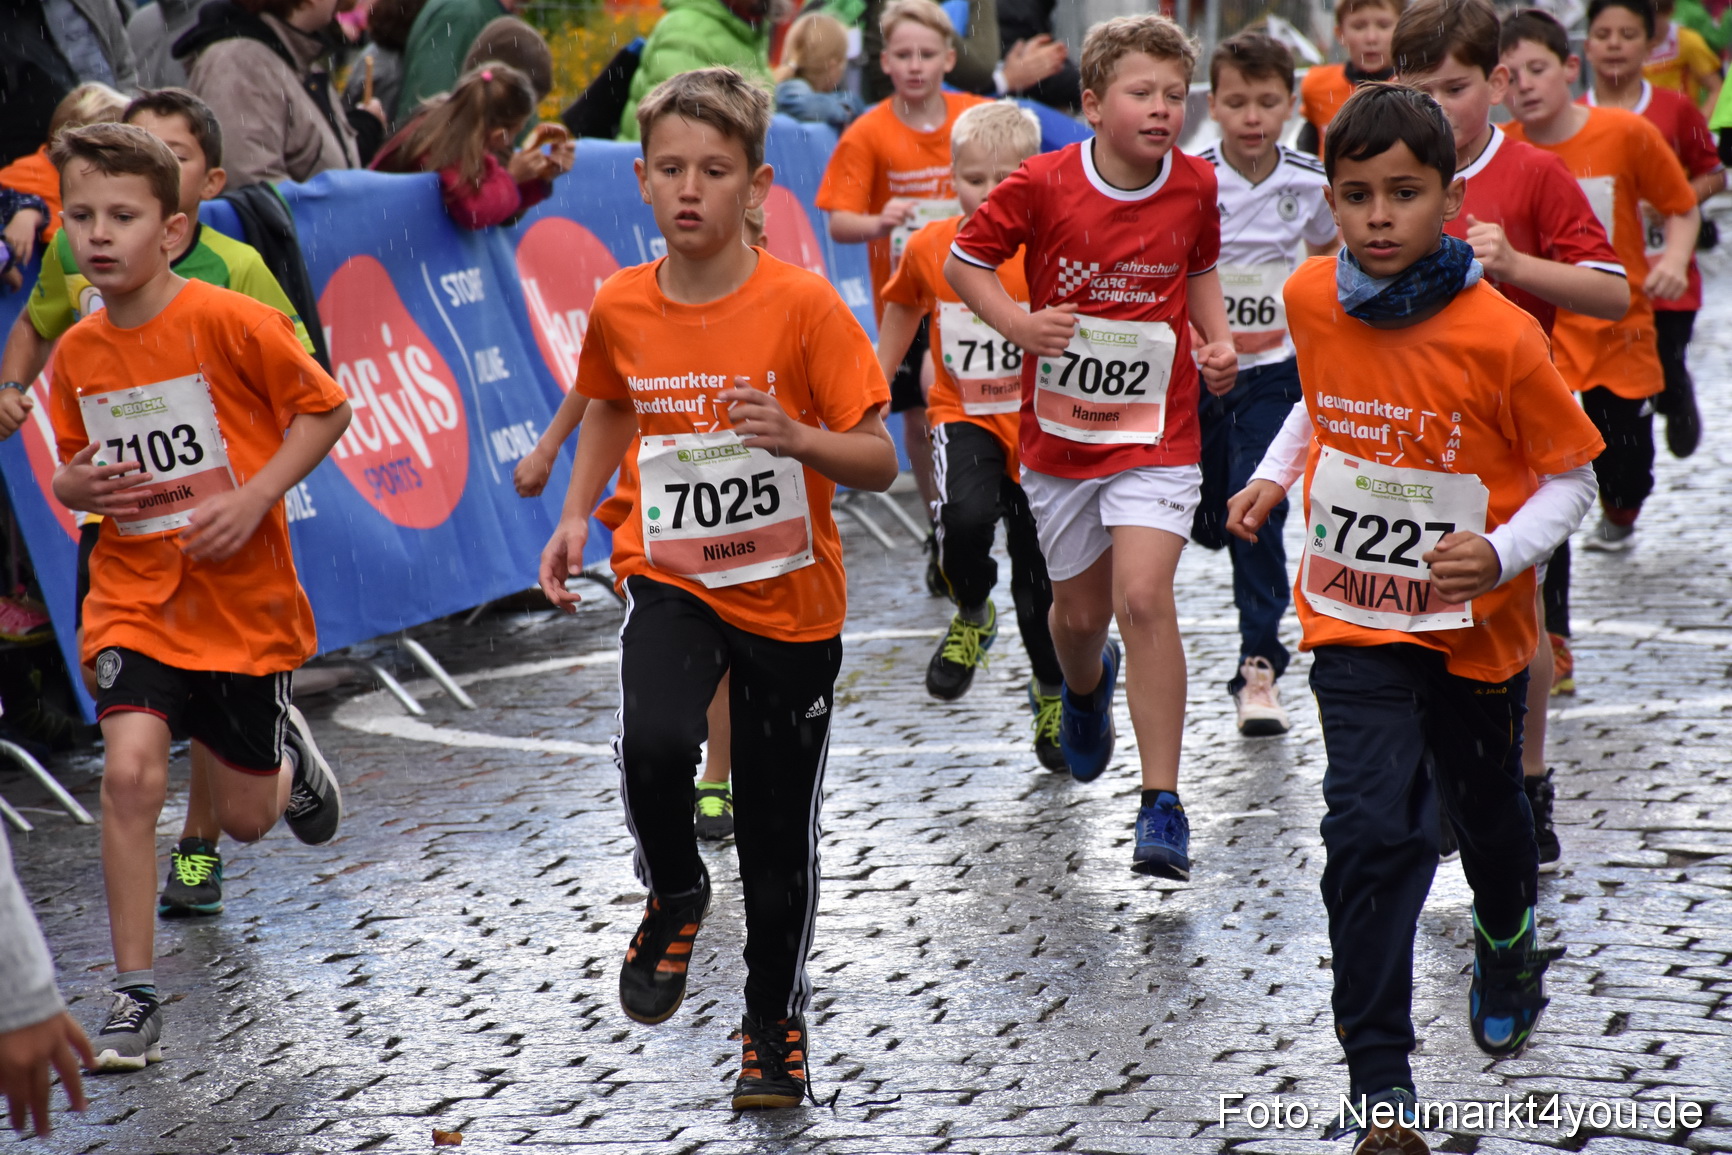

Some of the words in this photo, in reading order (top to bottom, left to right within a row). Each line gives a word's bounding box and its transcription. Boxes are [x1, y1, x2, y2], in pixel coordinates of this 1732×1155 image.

[1223, 296, 1276, 326] 266
[1091, 330, 1138, 345] BOCK
[957, 340, 1022, 372] 718
[627, 371, 727, 392] Neumarkter
[1058, 350, 1150, 396] 7082
[322, 321, 459, 469] ervis
[633, 394, 706, 415] Stadtlauf
[123, 397, 166, 415] BOCK
[1072, 404, 1120, 422] Hannes
[106, 424, 204, 478] 7103
[692, 444, 750, 461] BOCK
[364, 457, 423, 499] SPORTS
[1372, 479, 1434, 499] BOCK
[284, 482, 317, 523] BILE
[664, 470, 781, 530] 7025
[1169, 501, 1185, 512] JAKO
[649, 525, 661, 534] B6
[1331, 505, 1456, 569] 7227
[703, 541, 756, 561] Niklas
[1322, 566, 1431, 612] ANIAN
[805, 706, 828, 719] adidas
